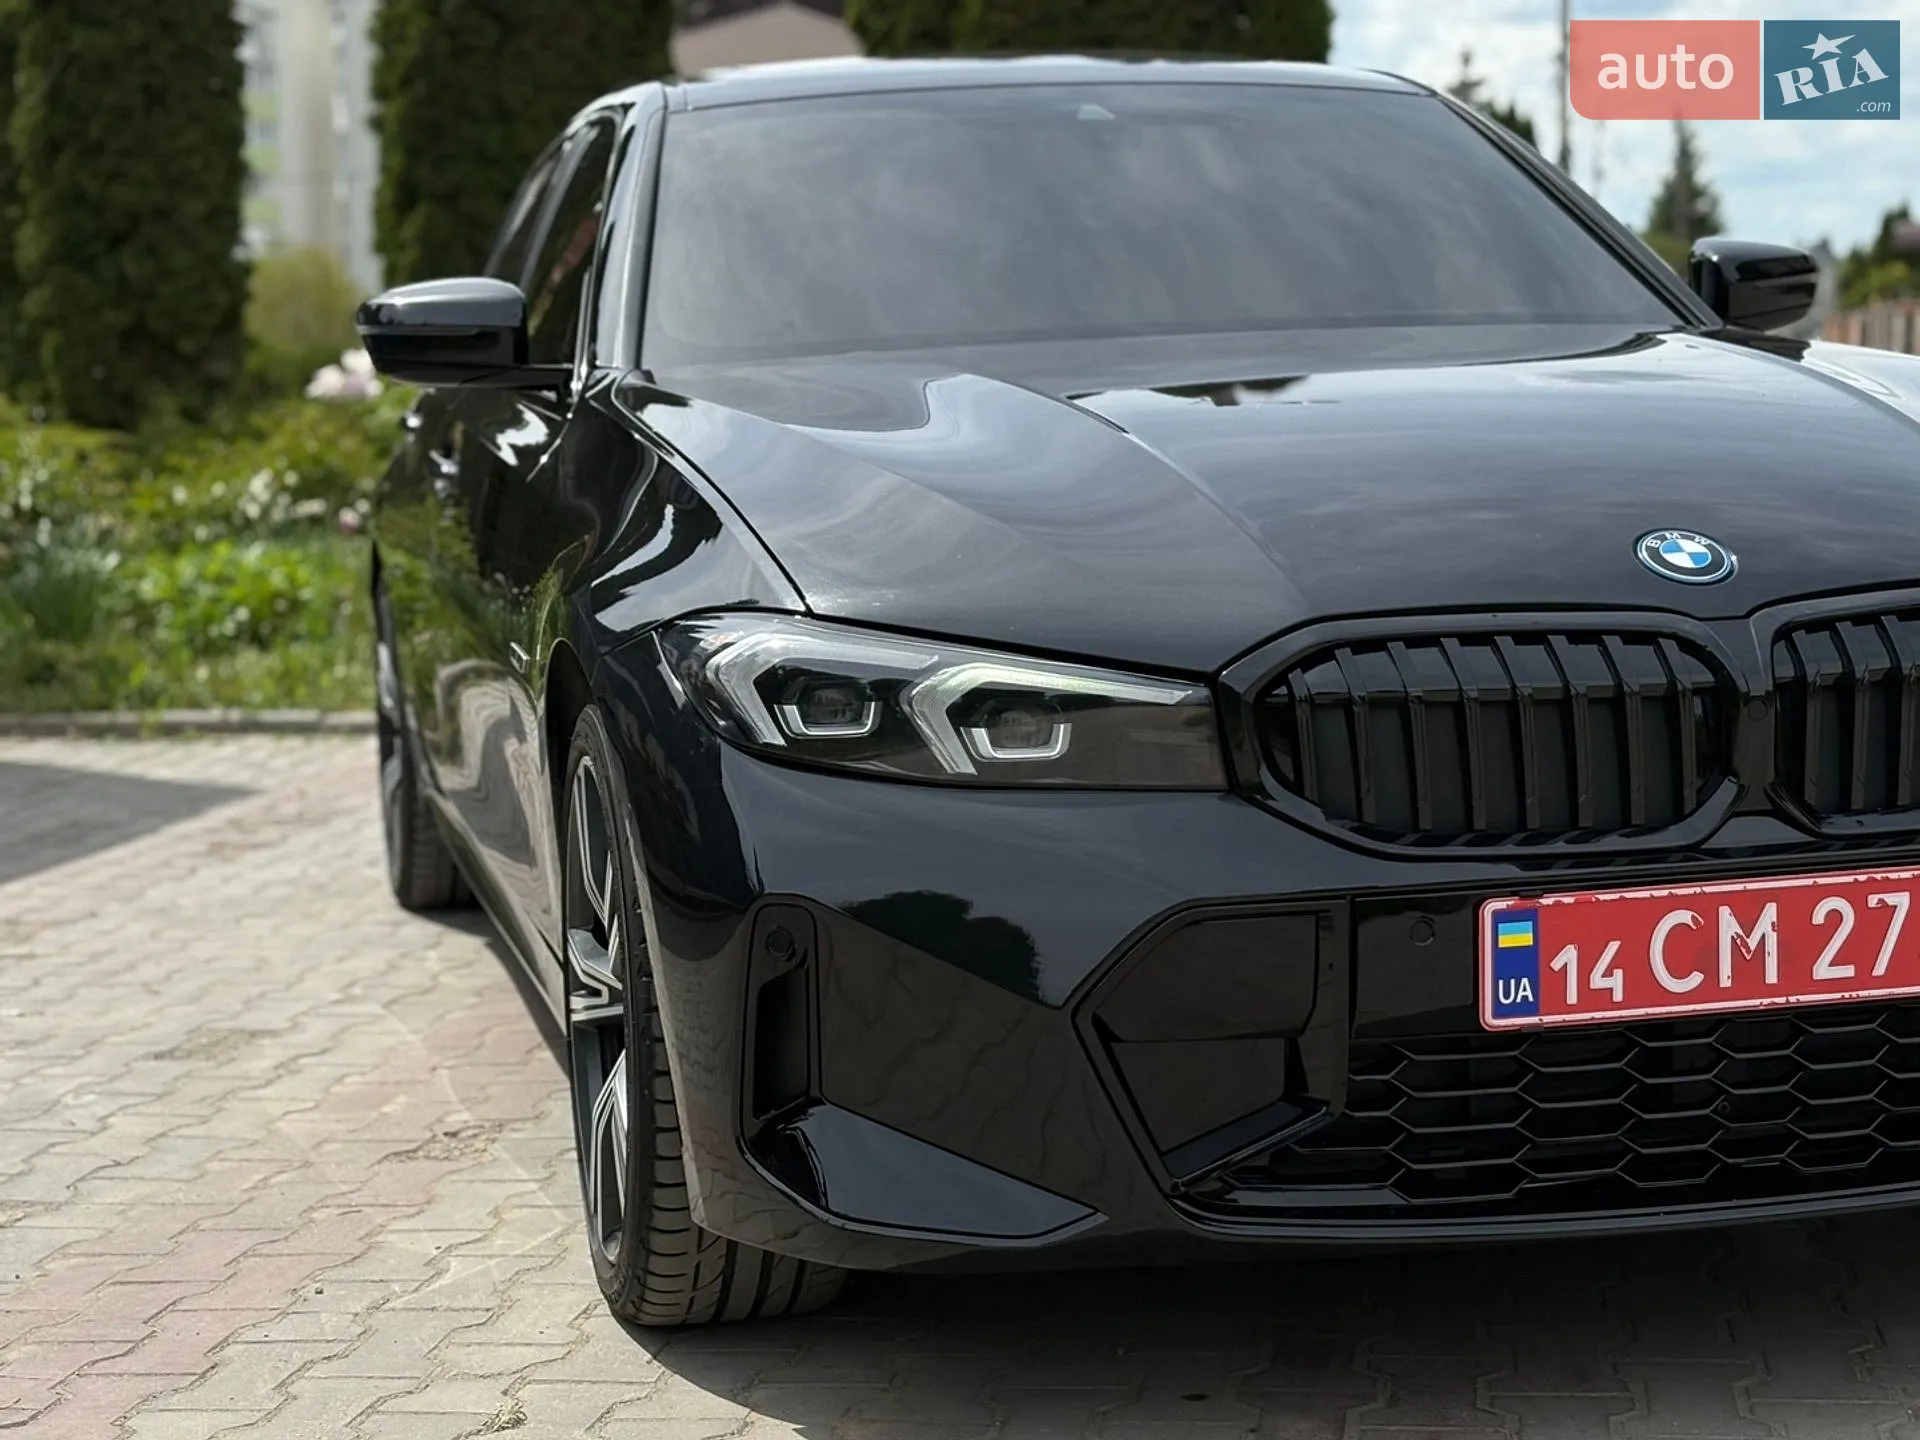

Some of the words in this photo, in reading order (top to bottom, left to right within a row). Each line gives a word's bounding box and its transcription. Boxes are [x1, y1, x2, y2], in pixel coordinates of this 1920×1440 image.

[1646, 532, 1709, 548] BMW
[1549, 940, 1623, 1005] 14
[1649, 902, 1778, 993] CM
[1811, 892, 1910, 980] 27
[1498, 978, 1534, 1004] UA
